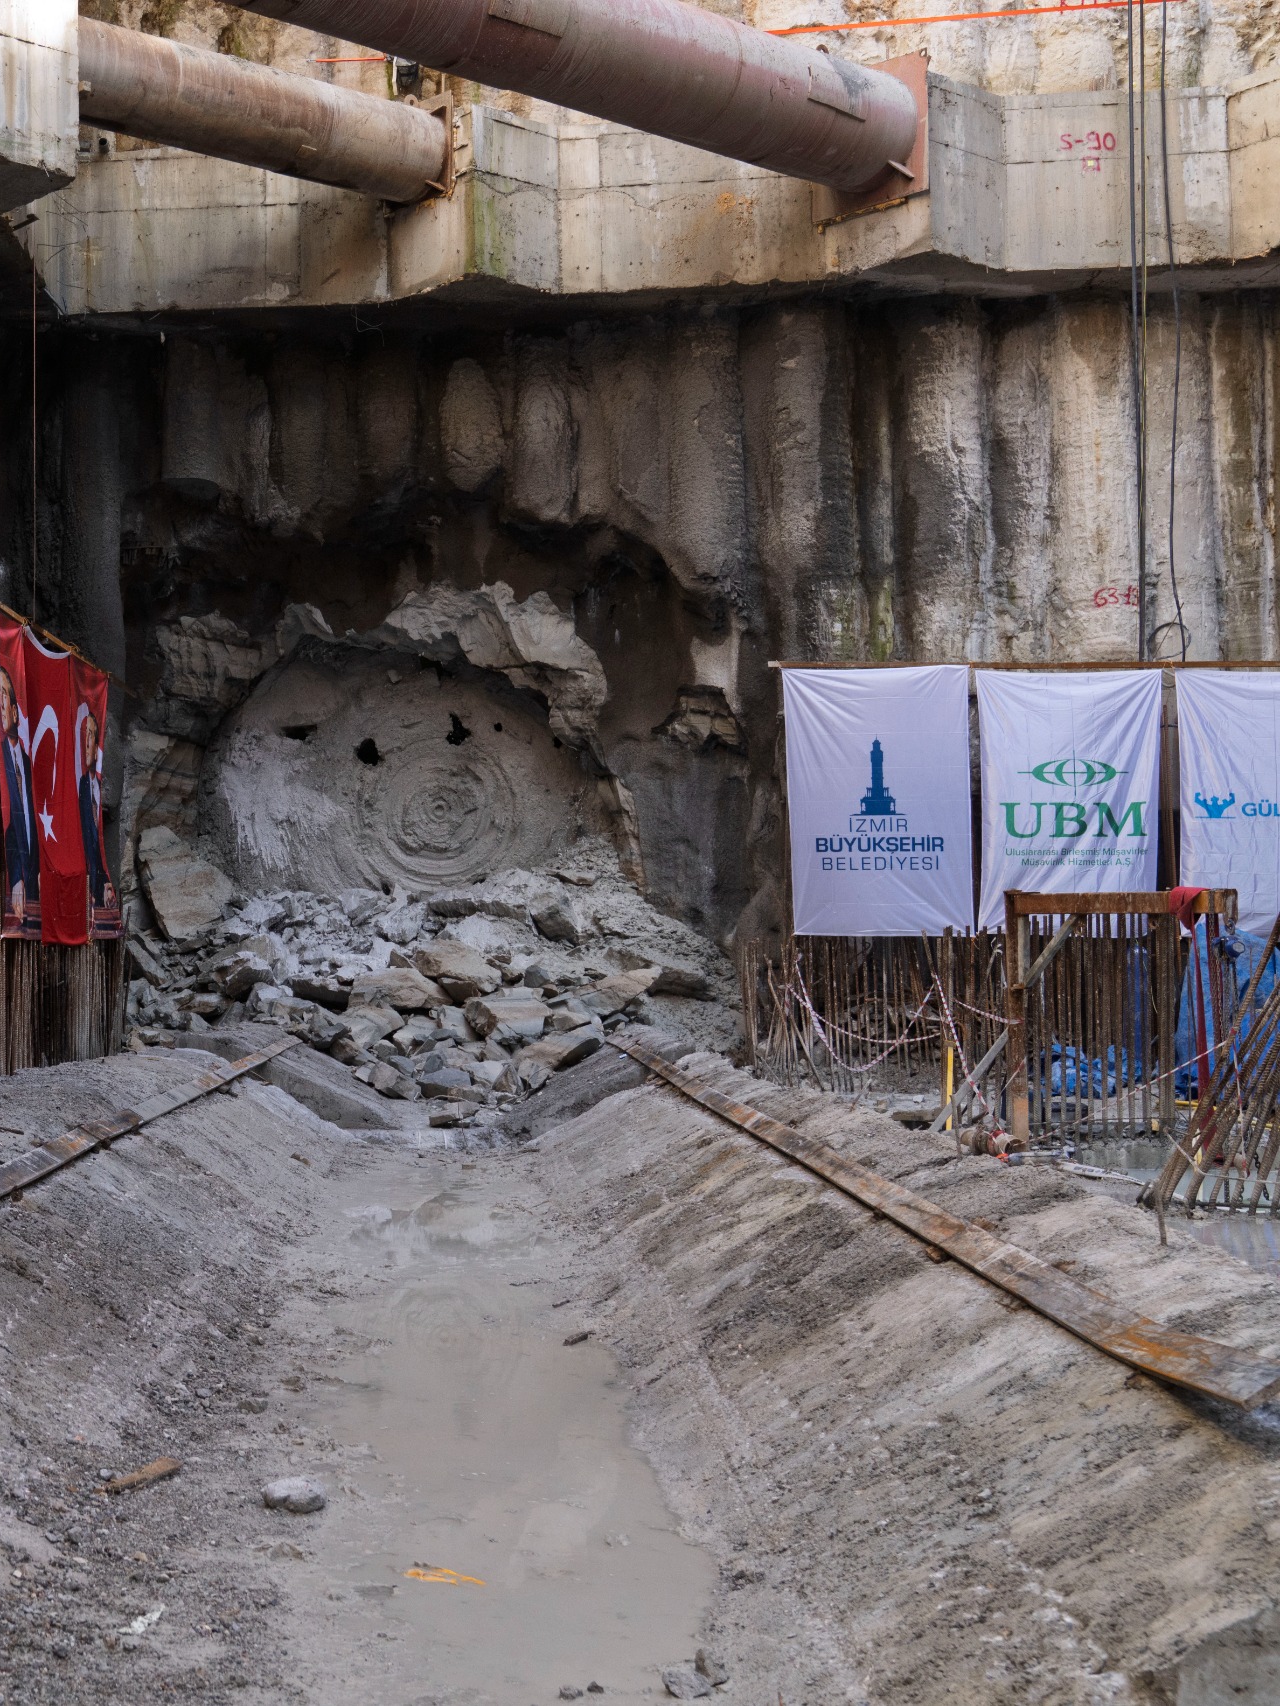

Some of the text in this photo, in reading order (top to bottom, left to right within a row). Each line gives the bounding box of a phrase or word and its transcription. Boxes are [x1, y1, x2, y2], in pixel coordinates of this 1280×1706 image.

[1241, 799, 1280, 817] GÜL
[849, 817, 908, 833] İZMİR
[999, 801, 1148, 838] UBM
[815, 834, 945, 854] BÜYÜKŞEHİR
[1005, 847, 1149, 857] Uluslararası Birleşmiş Müşavirler
[822, 855, 939, 871] BELEDİYESİ
[1068, 858, 1112, 866] Hizmetleri
